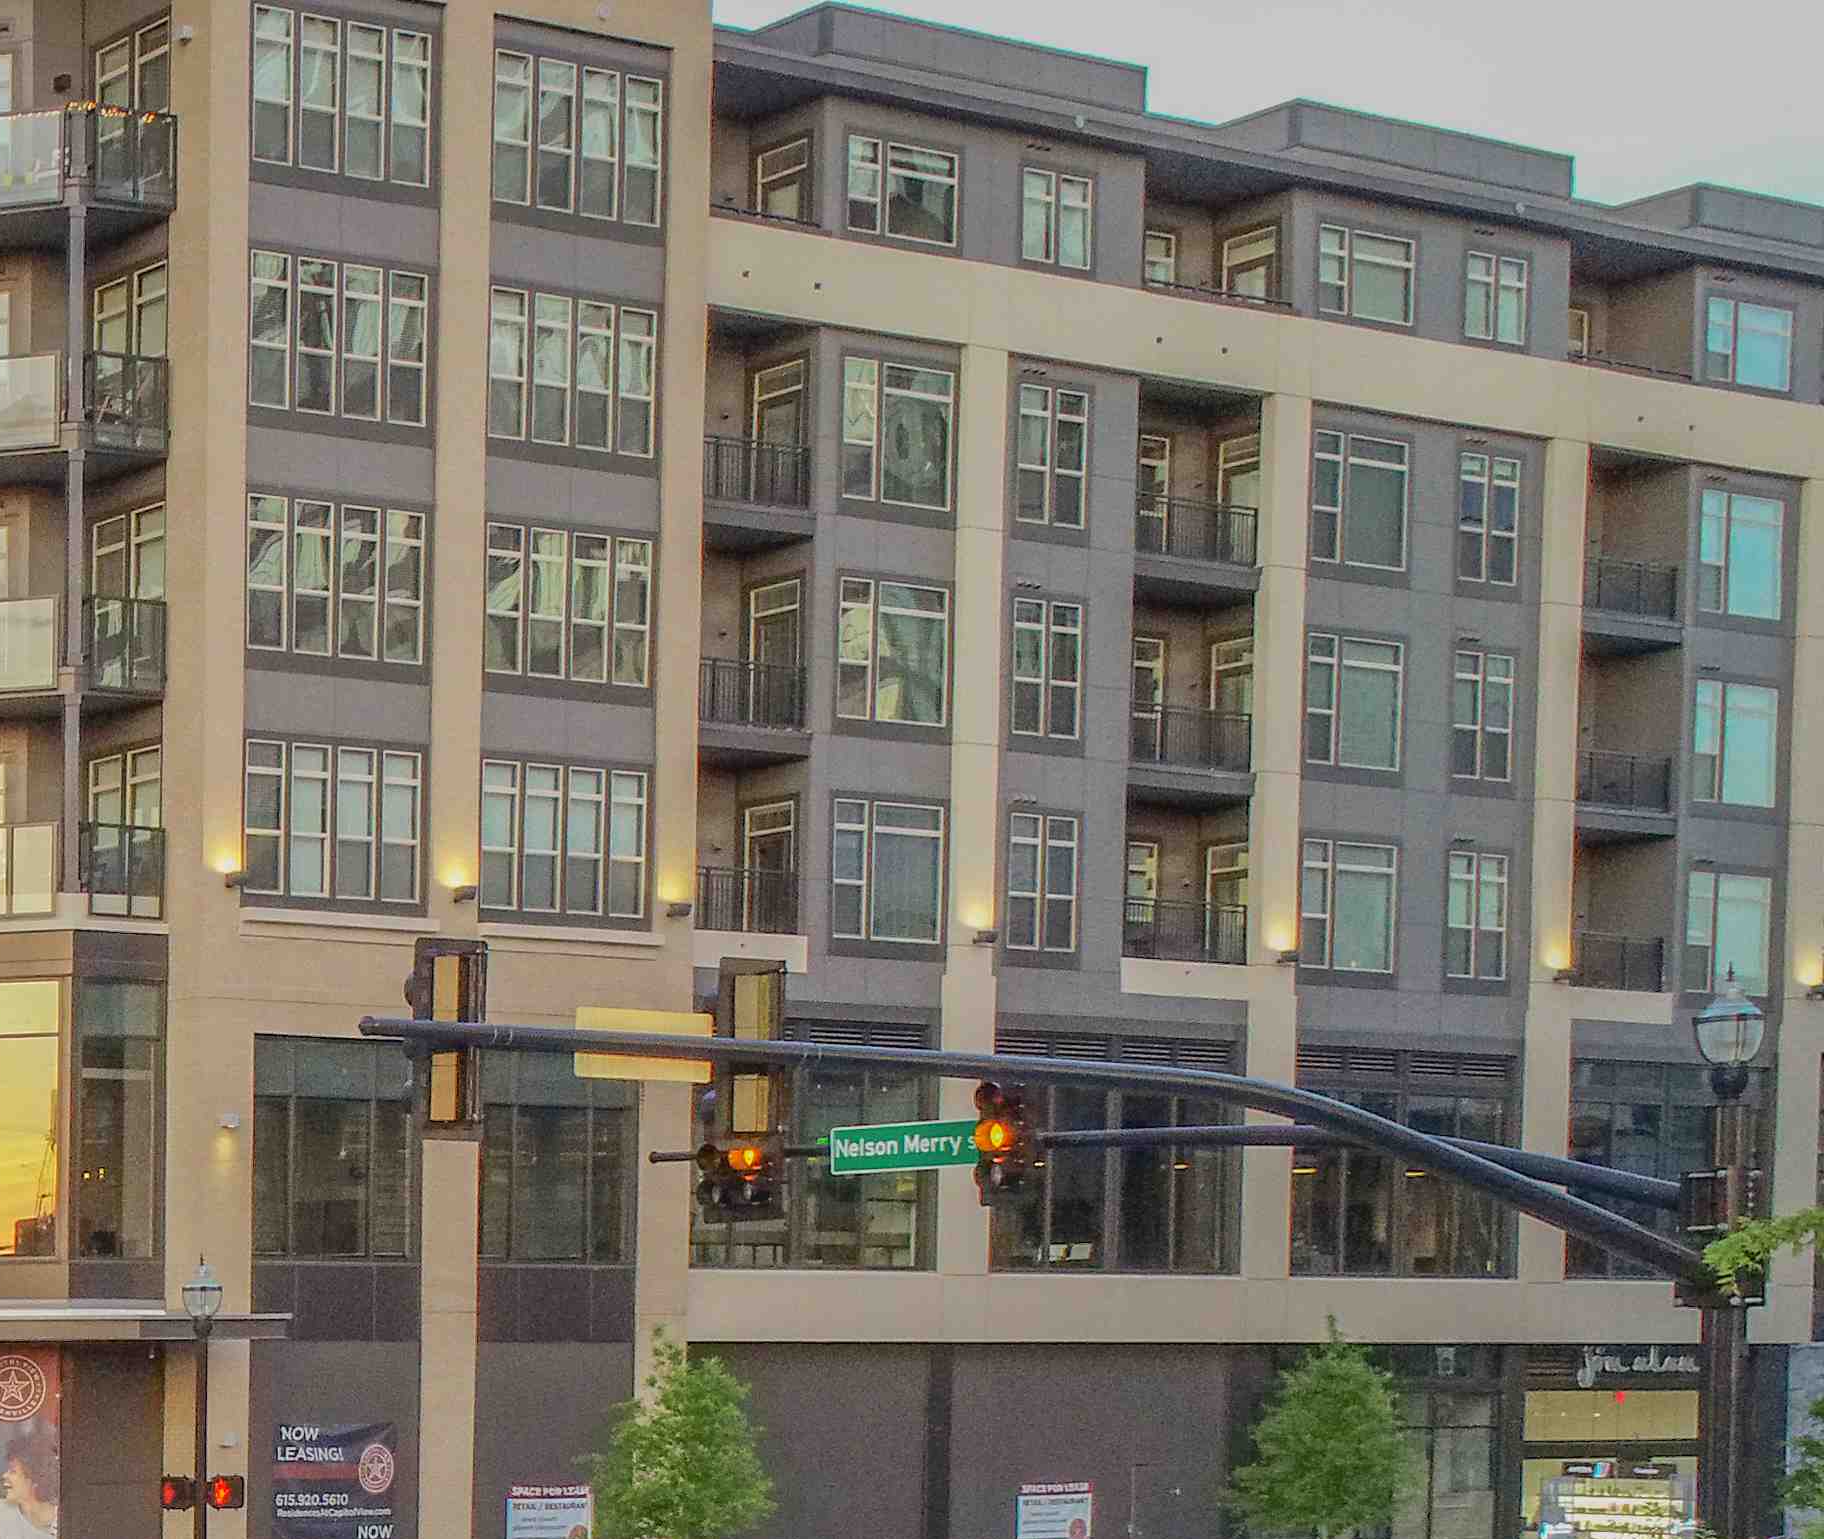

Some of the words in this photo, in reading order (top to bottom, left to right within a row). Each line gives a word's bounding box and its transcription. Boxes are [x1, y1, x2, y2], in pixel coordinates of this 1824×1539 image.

[835, 1137, 898, 1158] Nelson
[903, 1134, 962, 1156] Merry
[280, 1426, 319, 1441] NOW
[277, 1446, 345, 1462] LEASING!
[275, 1493, 349, 1507] 615.920.5610
[357, 1524, 393, 1539] NOW
